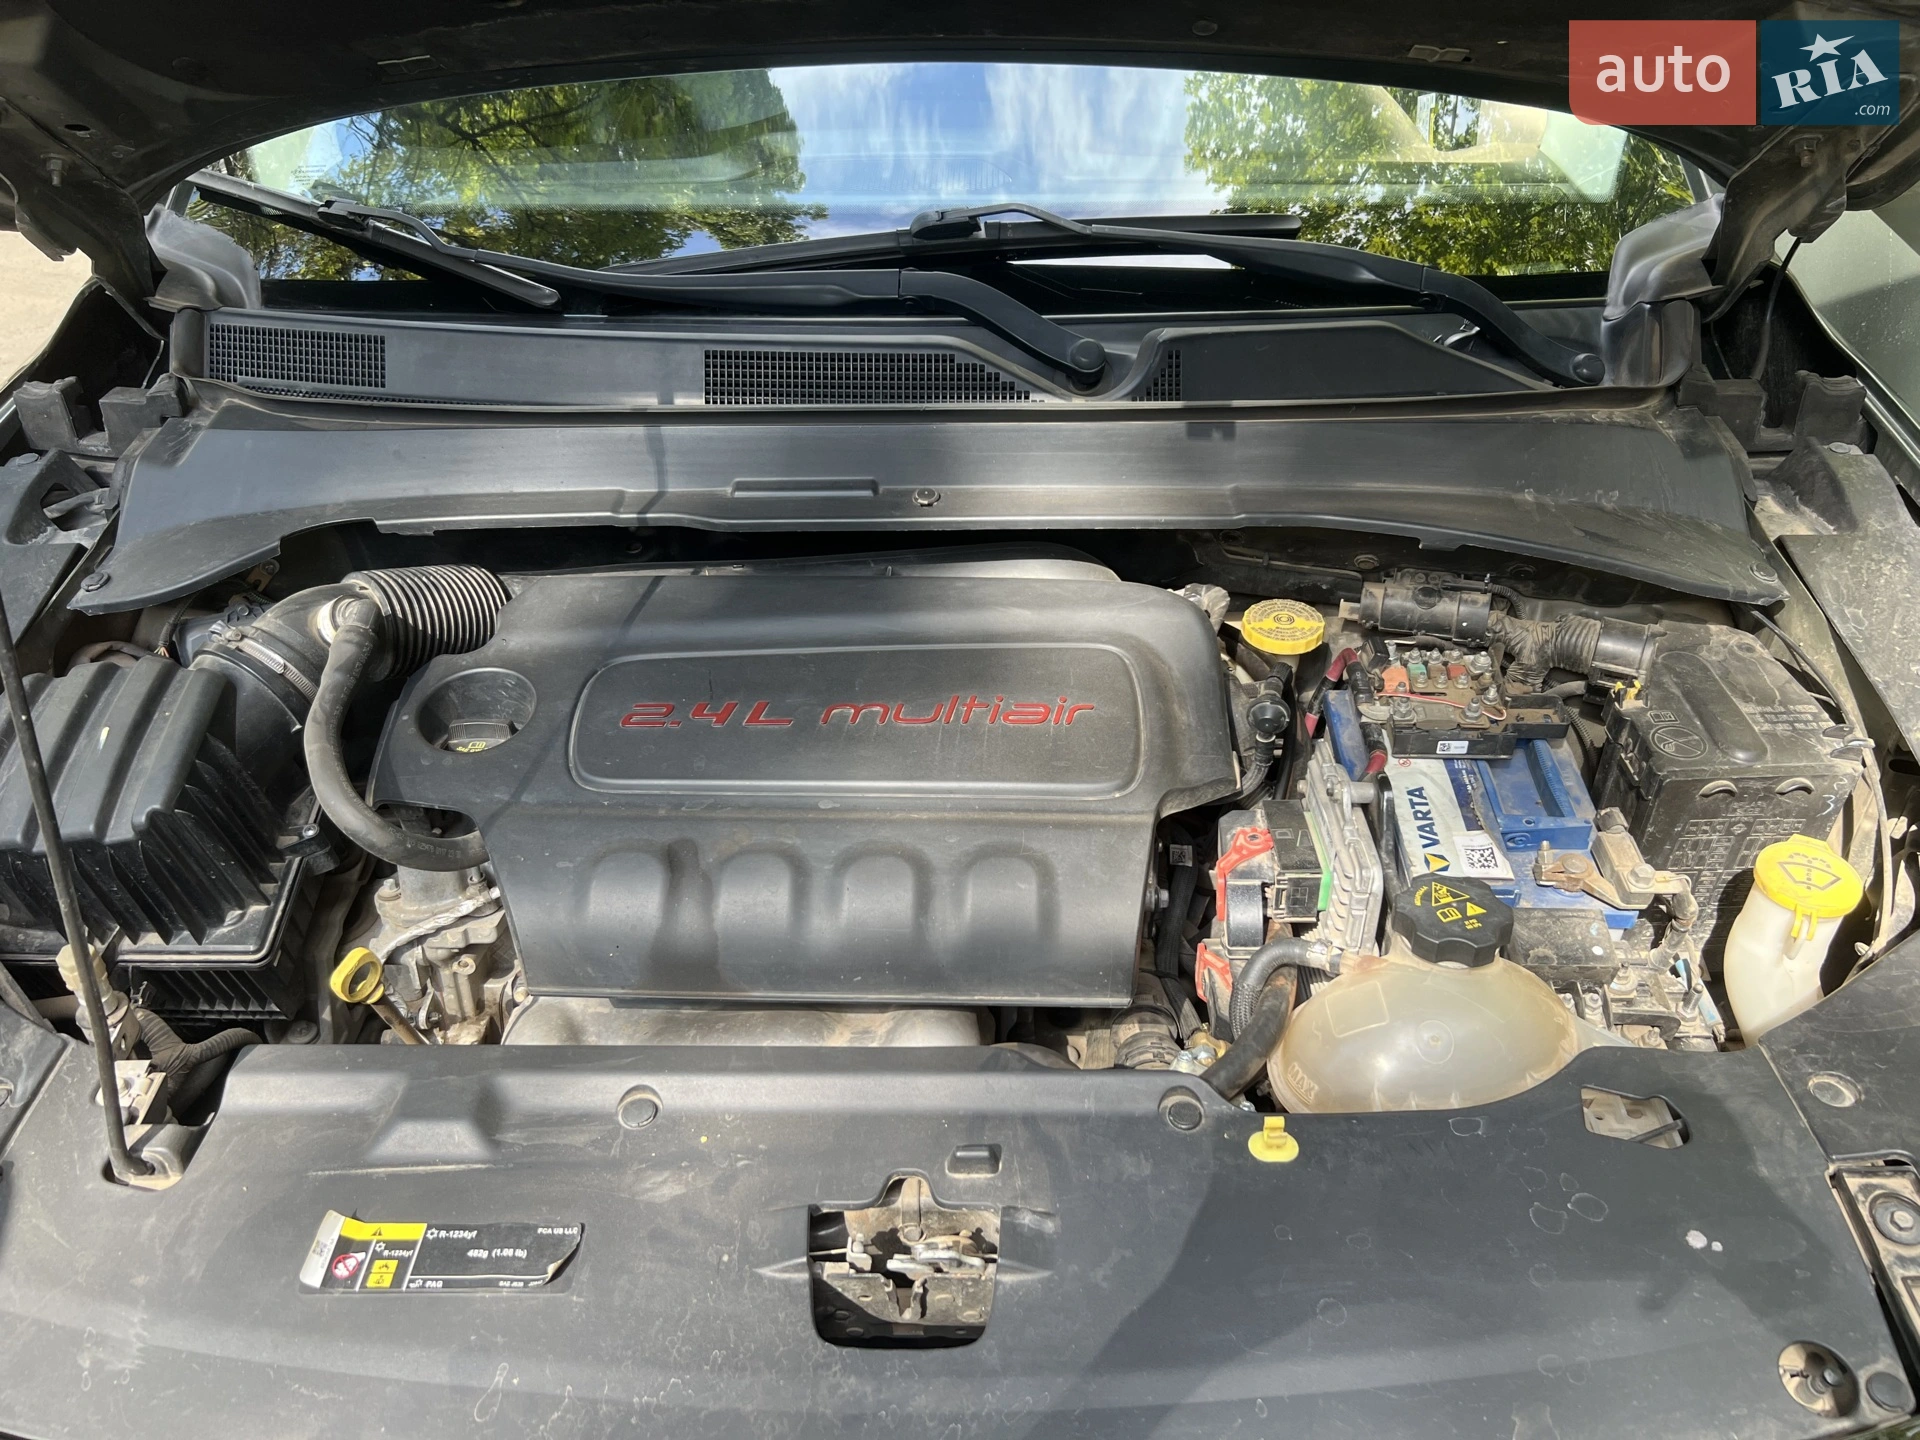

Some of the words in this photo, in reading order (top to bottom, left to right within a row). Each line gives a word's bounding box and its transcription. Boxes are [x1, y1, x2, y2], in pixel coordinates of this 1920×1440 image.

[820, 695, 1095, 726] multiair
[1406, 786, 1441, 849] VARTA
[1287, 1061, 1319, 1100] MAX
[438, 1229, 478, 1240] R-1234yf
[537, 1227, 553, 1235] FCA
[564, 1226, 579, 1235] LLC
[514, 1248, 528, 1259] lb)
